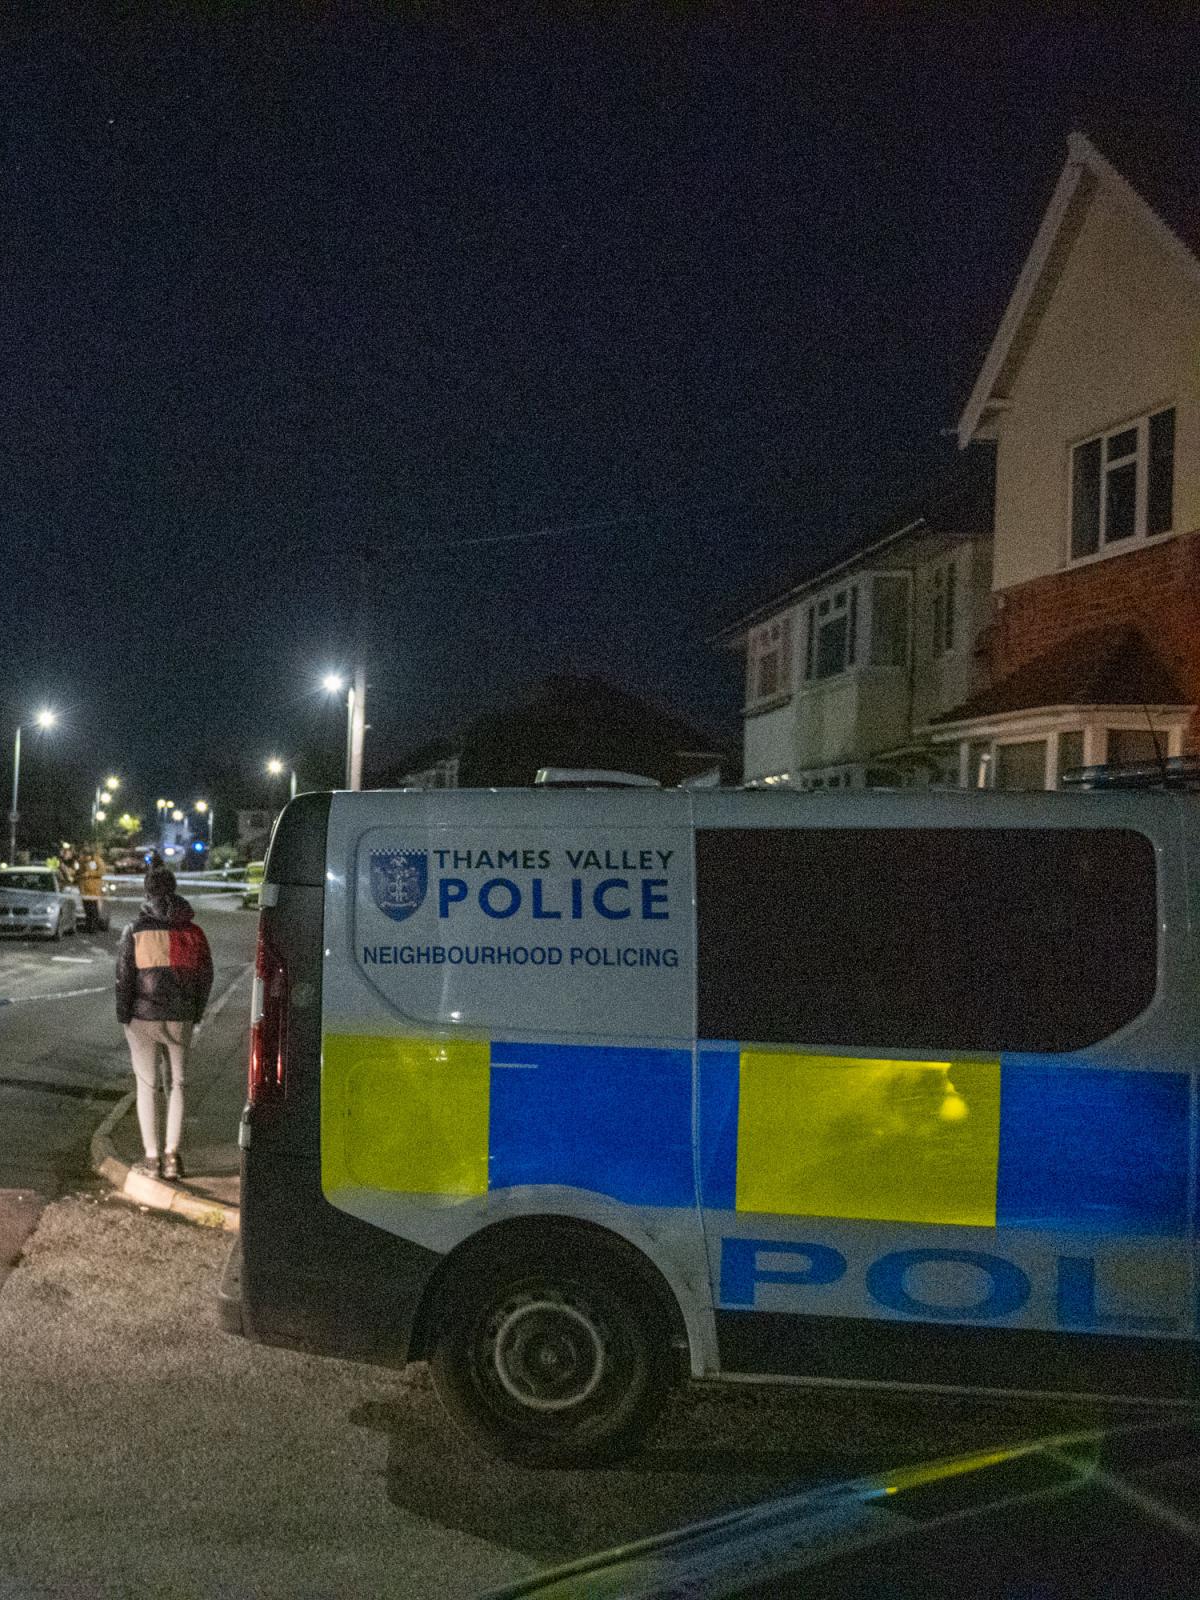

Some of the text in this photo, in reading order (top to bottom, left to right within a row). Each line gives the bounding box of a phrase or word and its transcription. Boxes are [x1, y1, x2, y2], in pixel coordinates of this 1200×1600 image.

[433, 849, 675, 870] THAMES VALLEY
[438, 877, 670, 921] POLICE
[362, 946, 680, 968] NEIGHBOURHOOD POLICING
